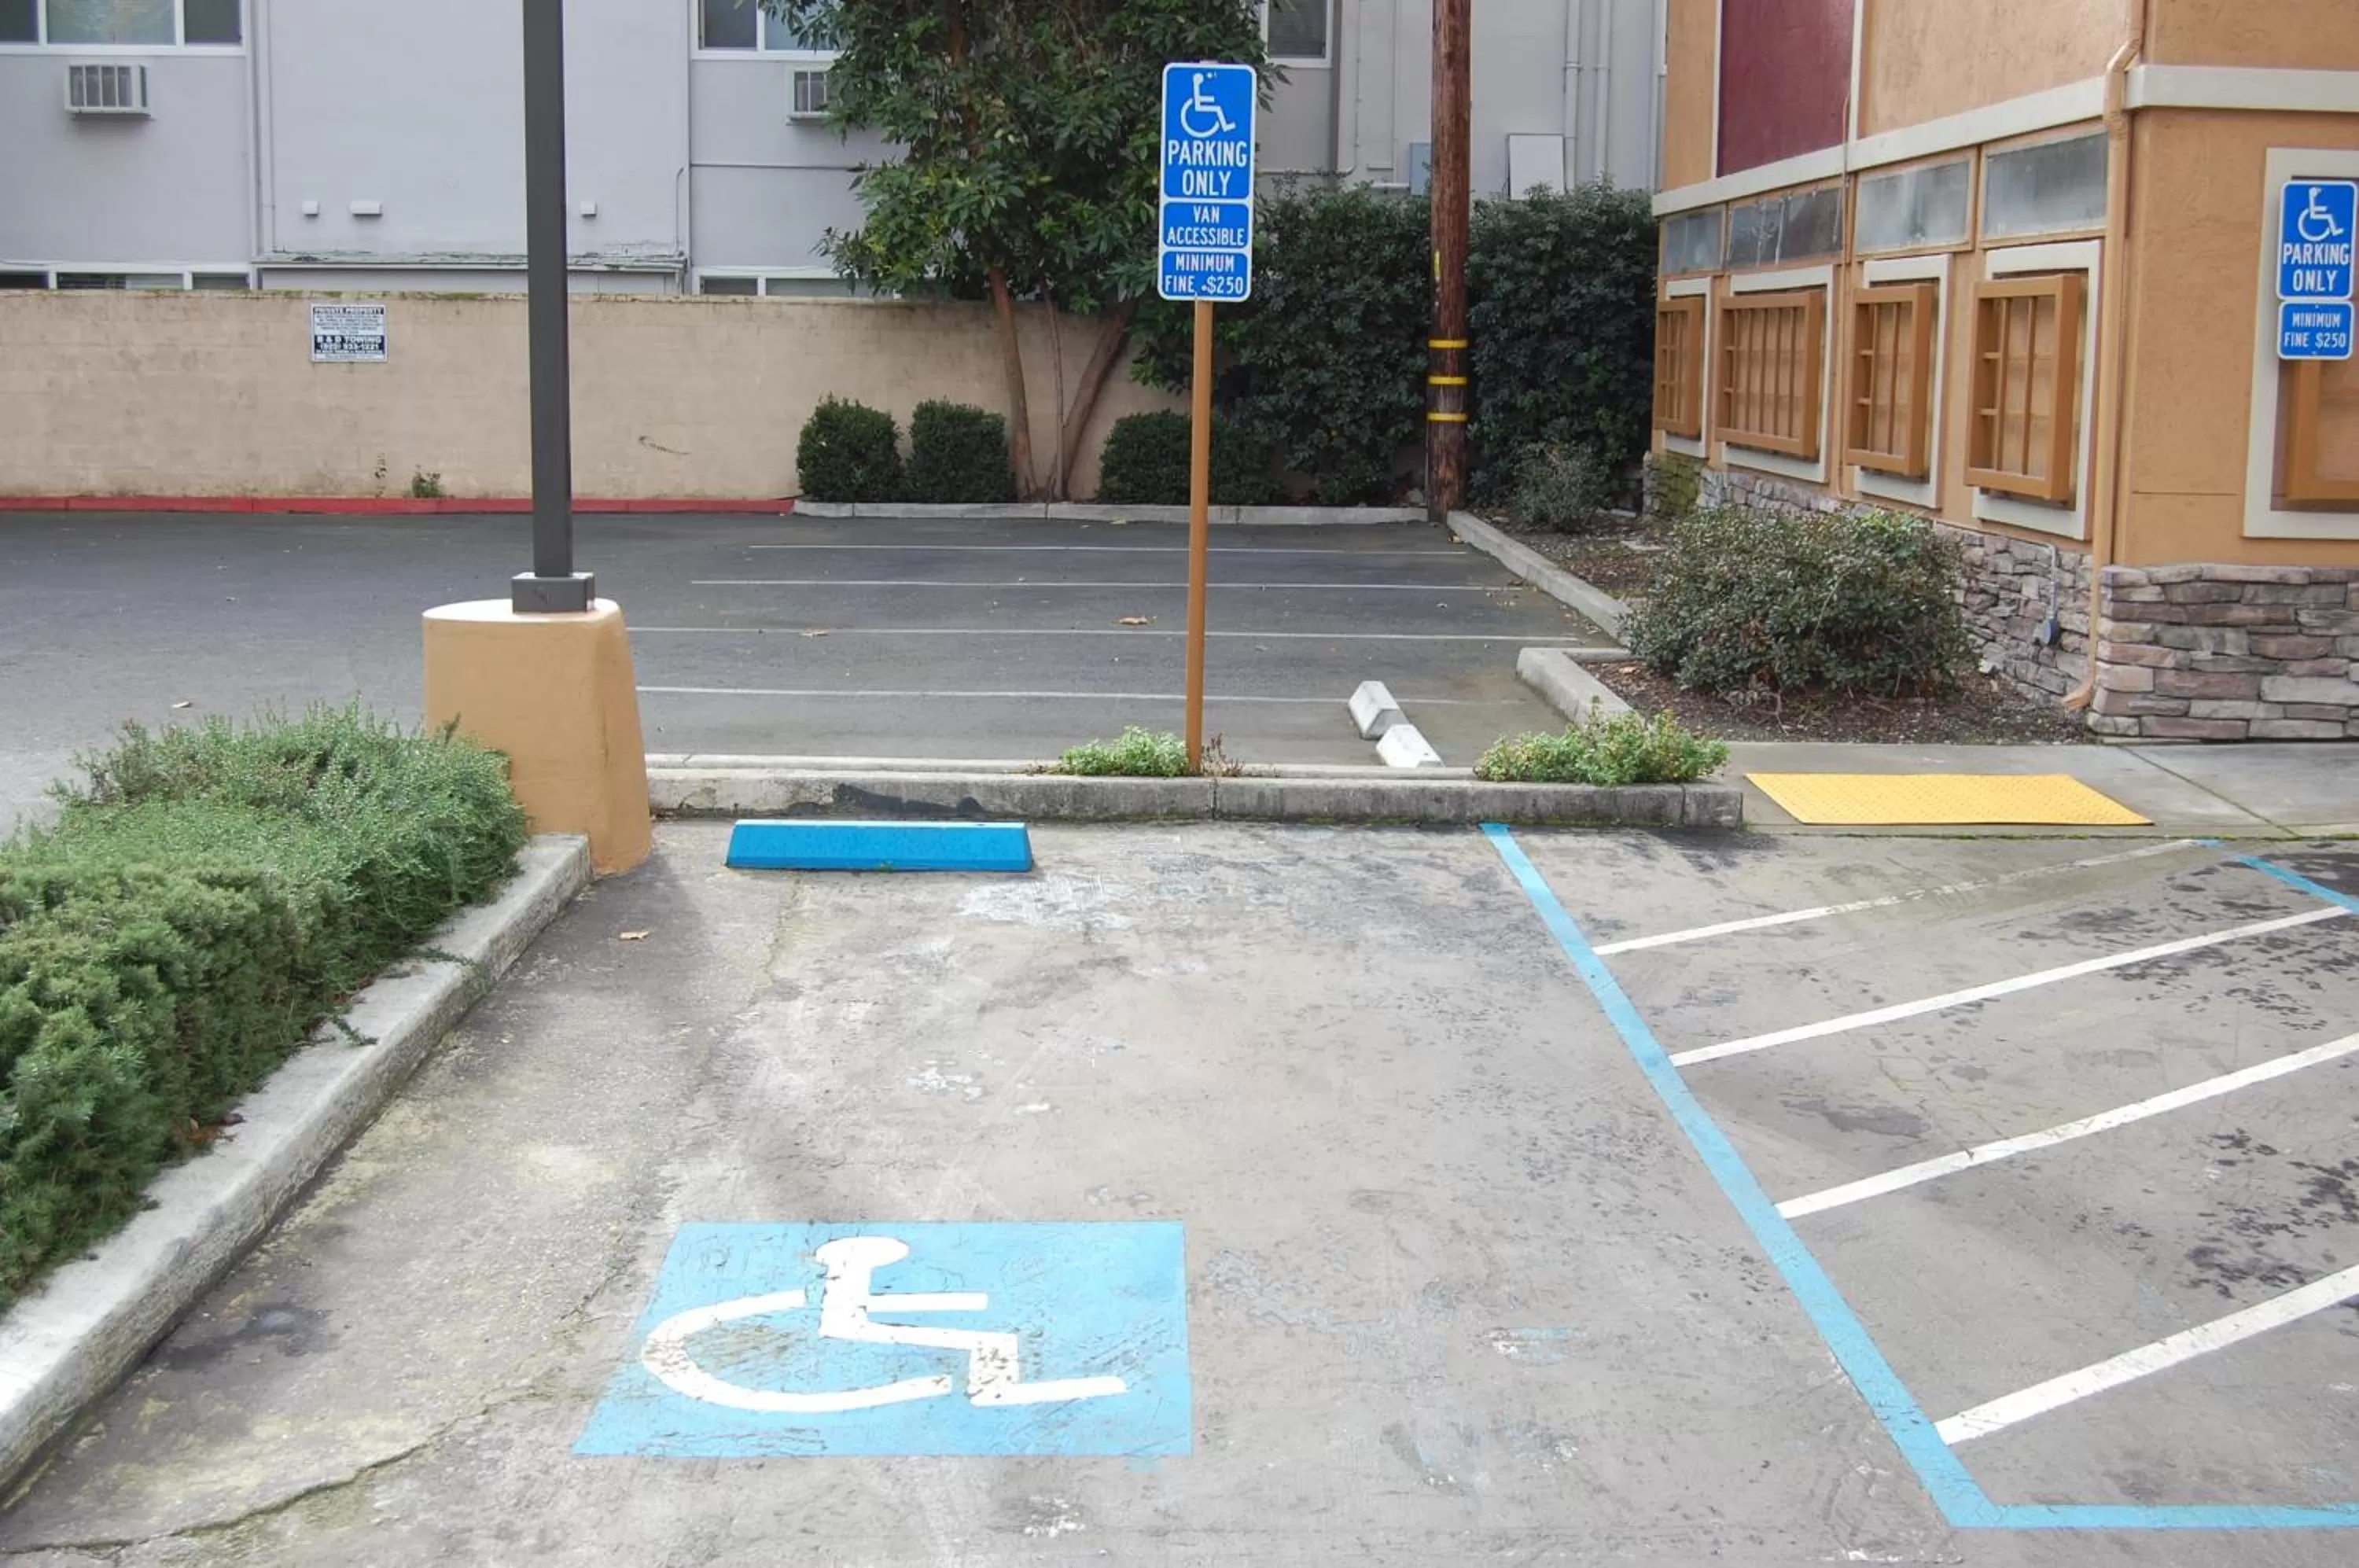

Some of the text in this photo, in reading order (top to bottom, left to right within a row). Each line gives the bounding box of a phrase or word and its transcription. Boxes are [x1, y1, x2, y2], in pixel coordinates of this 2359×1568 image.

[1168, 139, 1247, 167] PARKING
[1182, 170, 1232, 197] ONLY
[1193, 206, 1220, 223] VAN
[1167, 226, 1245, 246] ACCESSIBLE
[1176, 253, 1235, 272] MINIMUM
[2283, 242, 2350, 265] PARKING
[1165, 274, 1244, 295] FINE $250
[2292, 270, 2339, 292] ONLY
[2292, 312, 2341, 328] MINIMUM
[2284, 332, 2346, 348] FINE $250
